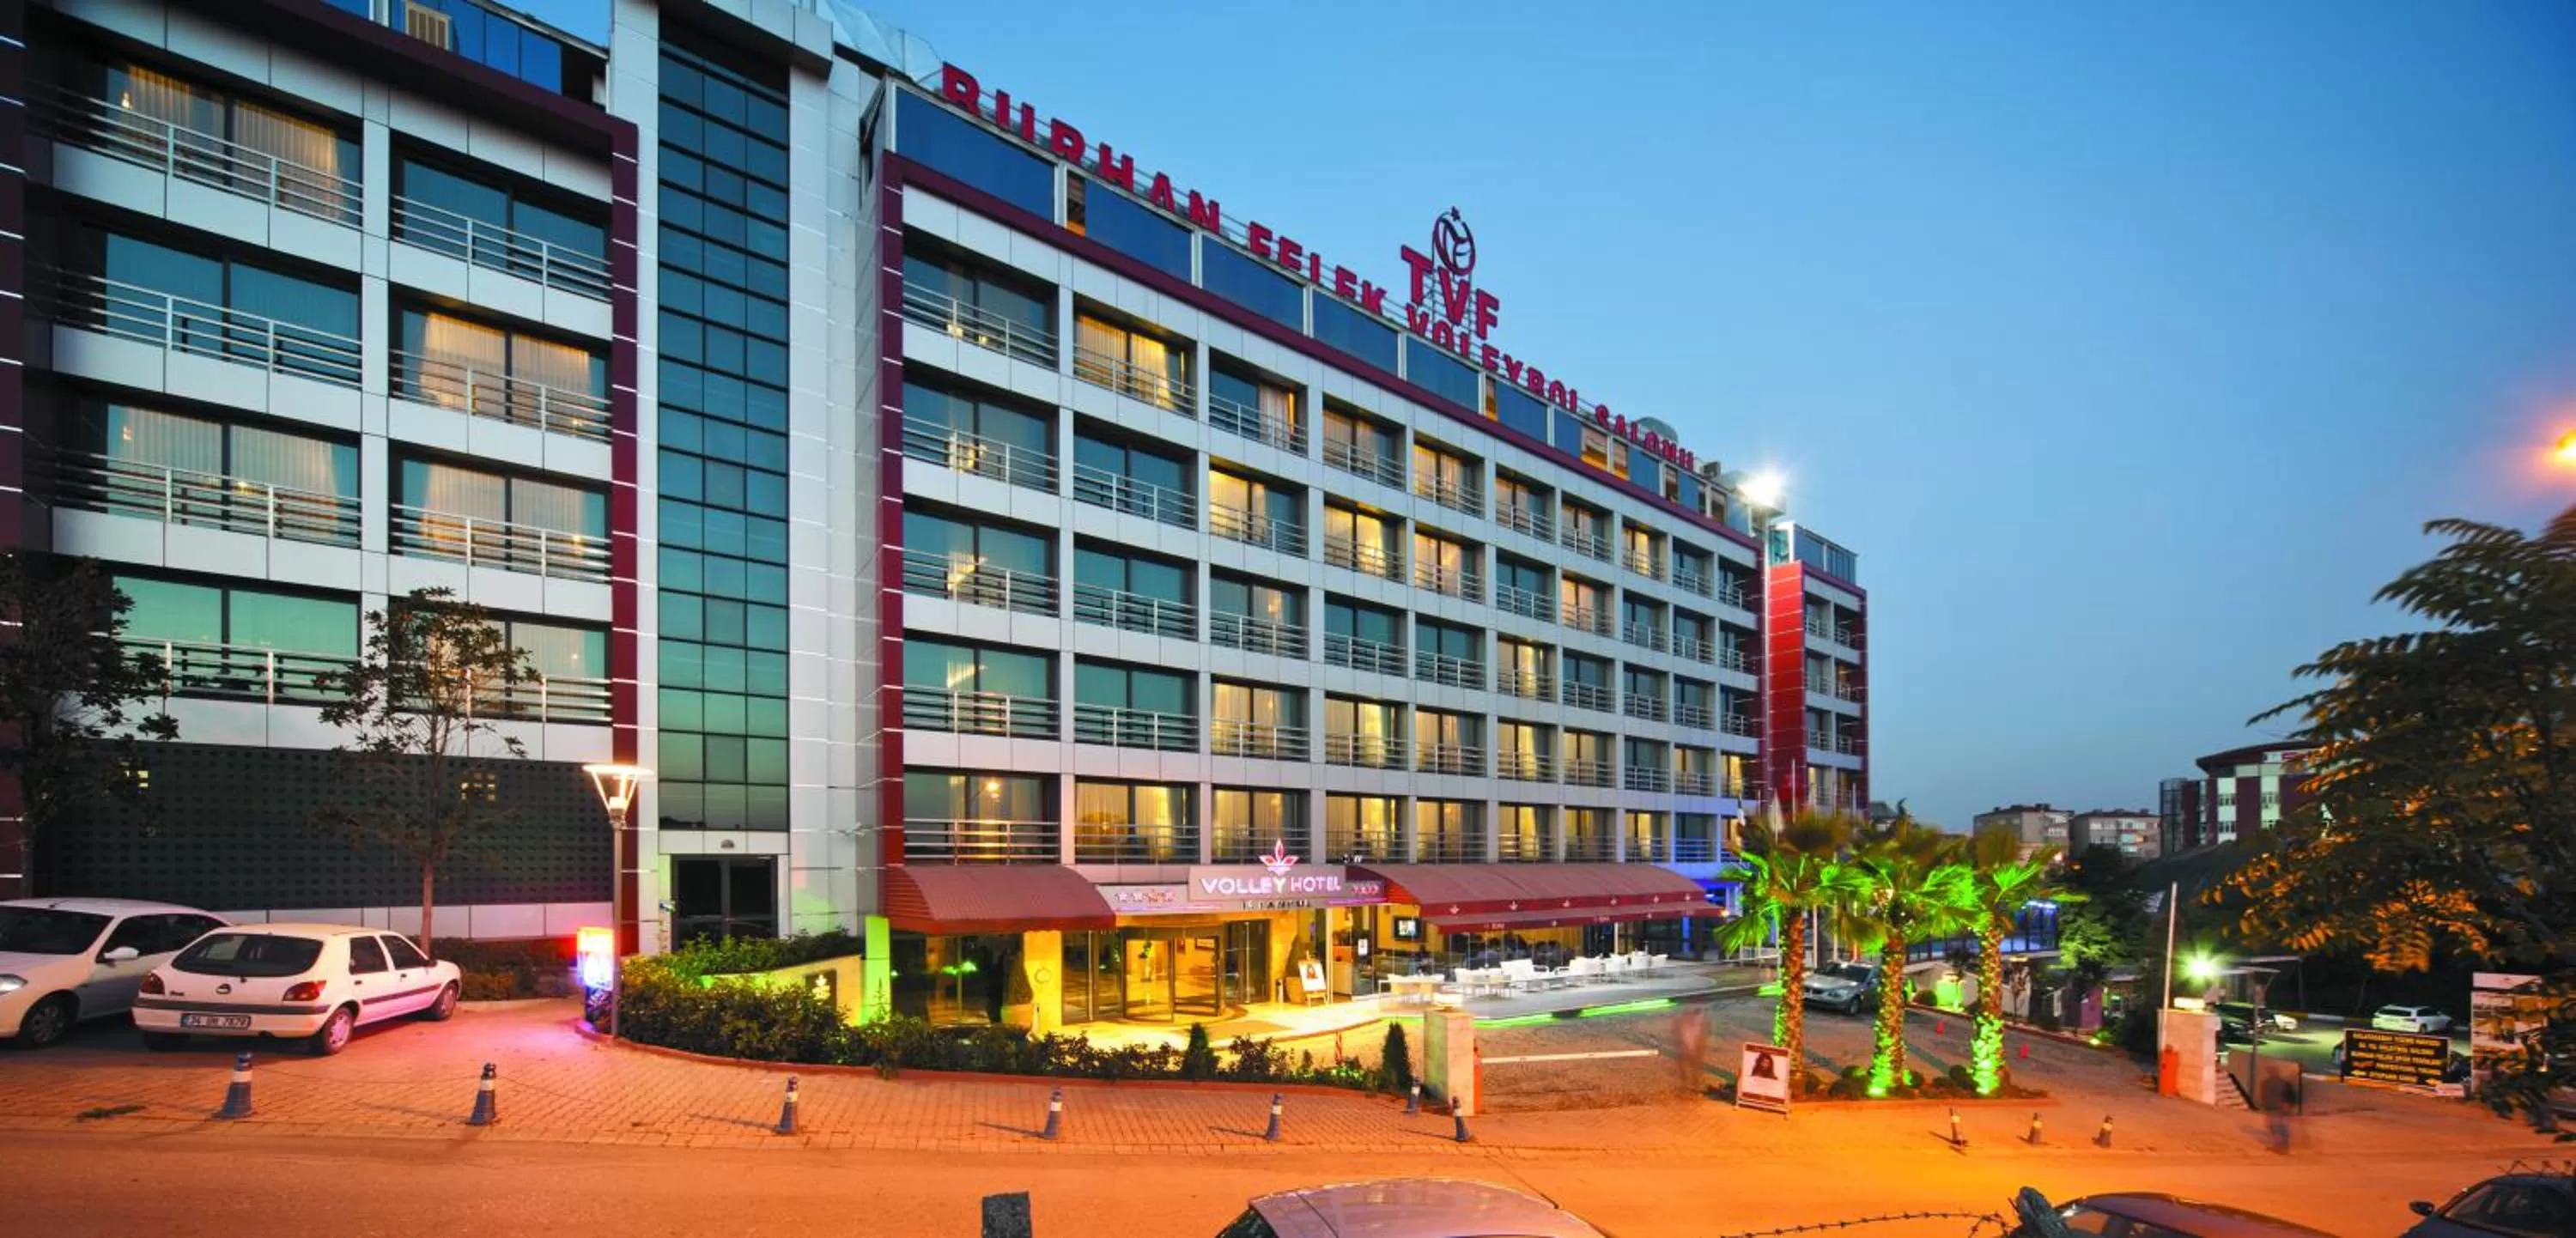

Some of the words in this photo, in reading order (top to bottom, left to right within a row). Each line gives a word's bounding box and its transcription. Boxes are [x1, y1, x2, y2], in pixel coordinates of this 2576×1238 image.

[1401, 245, 1499, 340] TVF
[1201, 877, 1286, 895] VOLLEY
[1291, 876, 1341, 892] HOTEL
